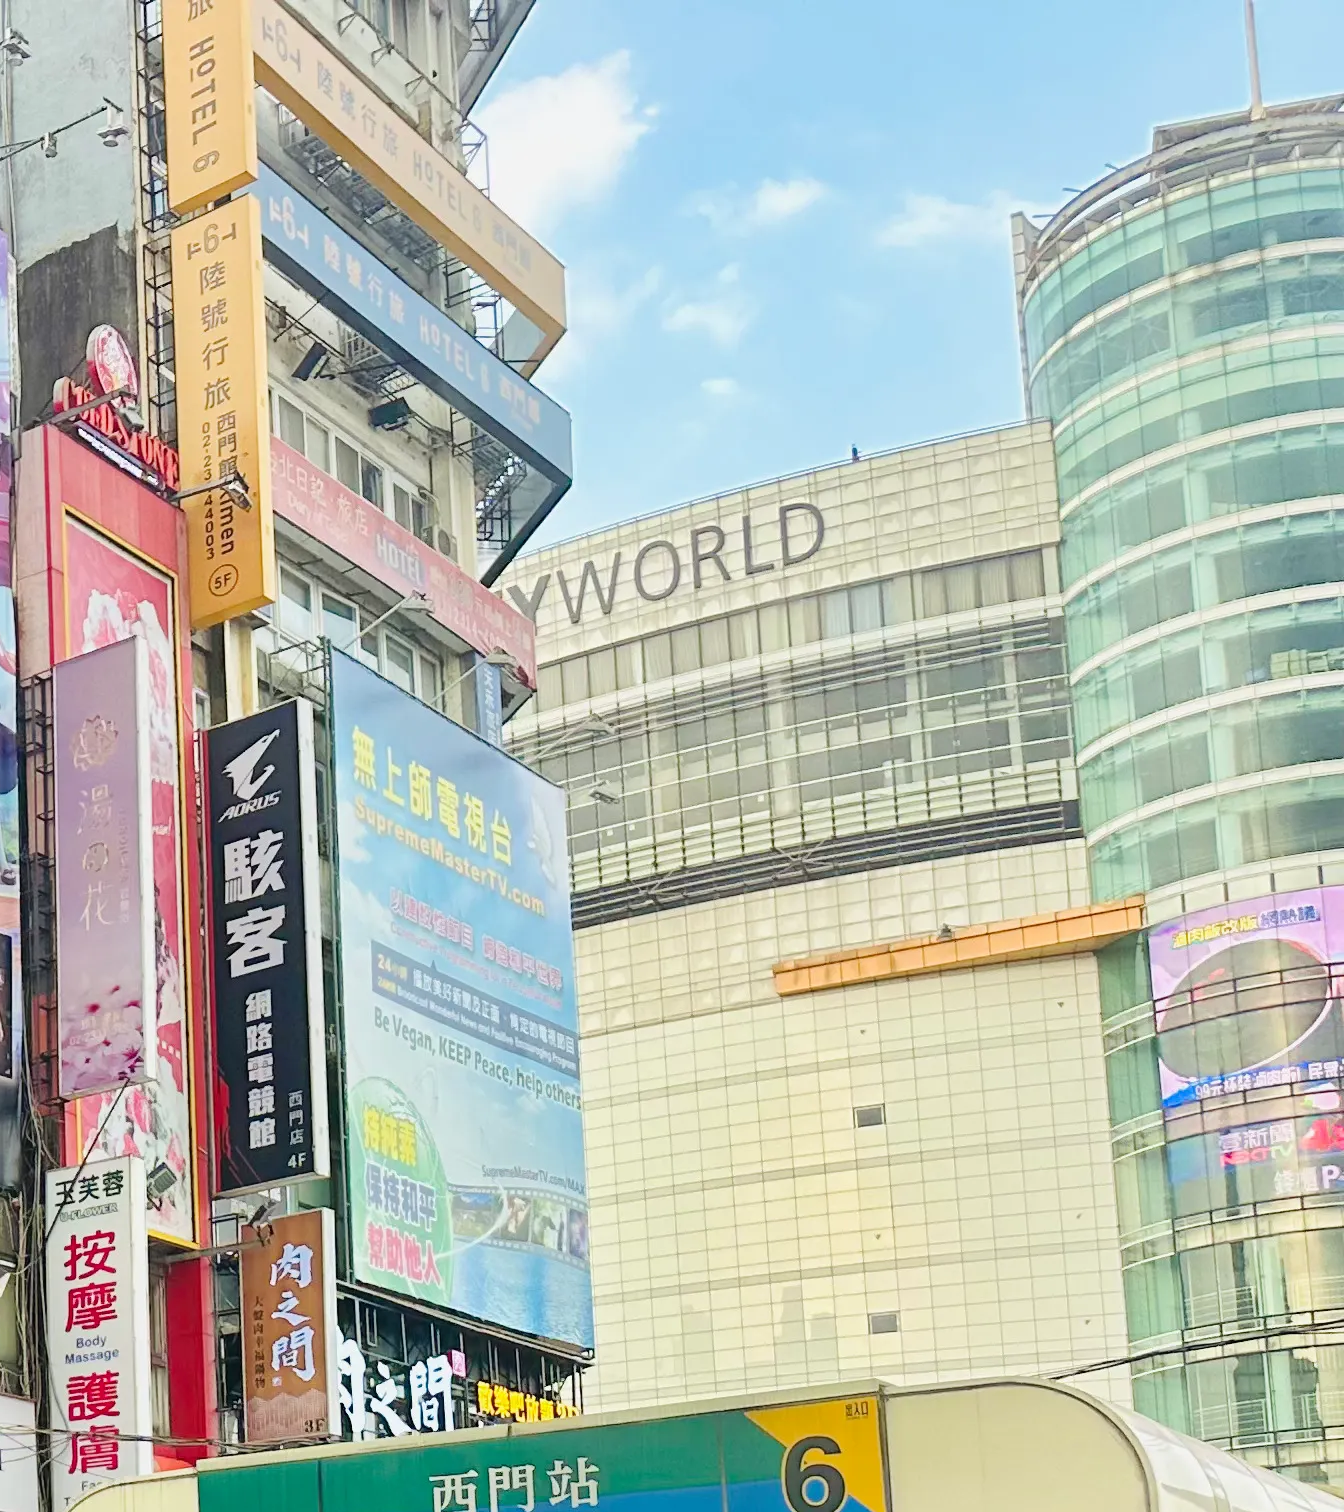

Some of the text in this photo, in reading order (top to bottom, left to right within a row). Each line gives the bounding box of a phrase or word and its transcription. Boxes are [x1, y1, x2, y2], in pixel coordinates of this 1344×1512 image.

[188, 35, 218, 146] HOTEL
[199, 266, 232, 412] 陸號行旅
[201, 422, 216, 560] 02-2344003
[214, 574, 232, 591] 5F
[374, 533, 422, 586] HOTEL
[217, 789, 282, 824] AORUS
[352, 725, 512, 867] 無上師電視台
[224, 828, 288, 978] 駭客
[354, 796, 546, 917] SupremeMasterTV.com
[374, 1005, 582, 1112] Be Vegan, KEEP Peace, help others
[287, 1151, 307, 1170] 4F
[288, 1090, 306, 1147] 西門店
[55, 1169, 125, 1207] 玉芙蓉
[63, 1229, 118, 1333] 按摩
[269, 1242, 316, 1382] 肉之間
[64, 1348, 120, 1366] Massage
[75, 1335, 108, 1349] Body
[67, 1369, 122, 1475] 護膚
[303, 1417, 326, 1434] 3F
